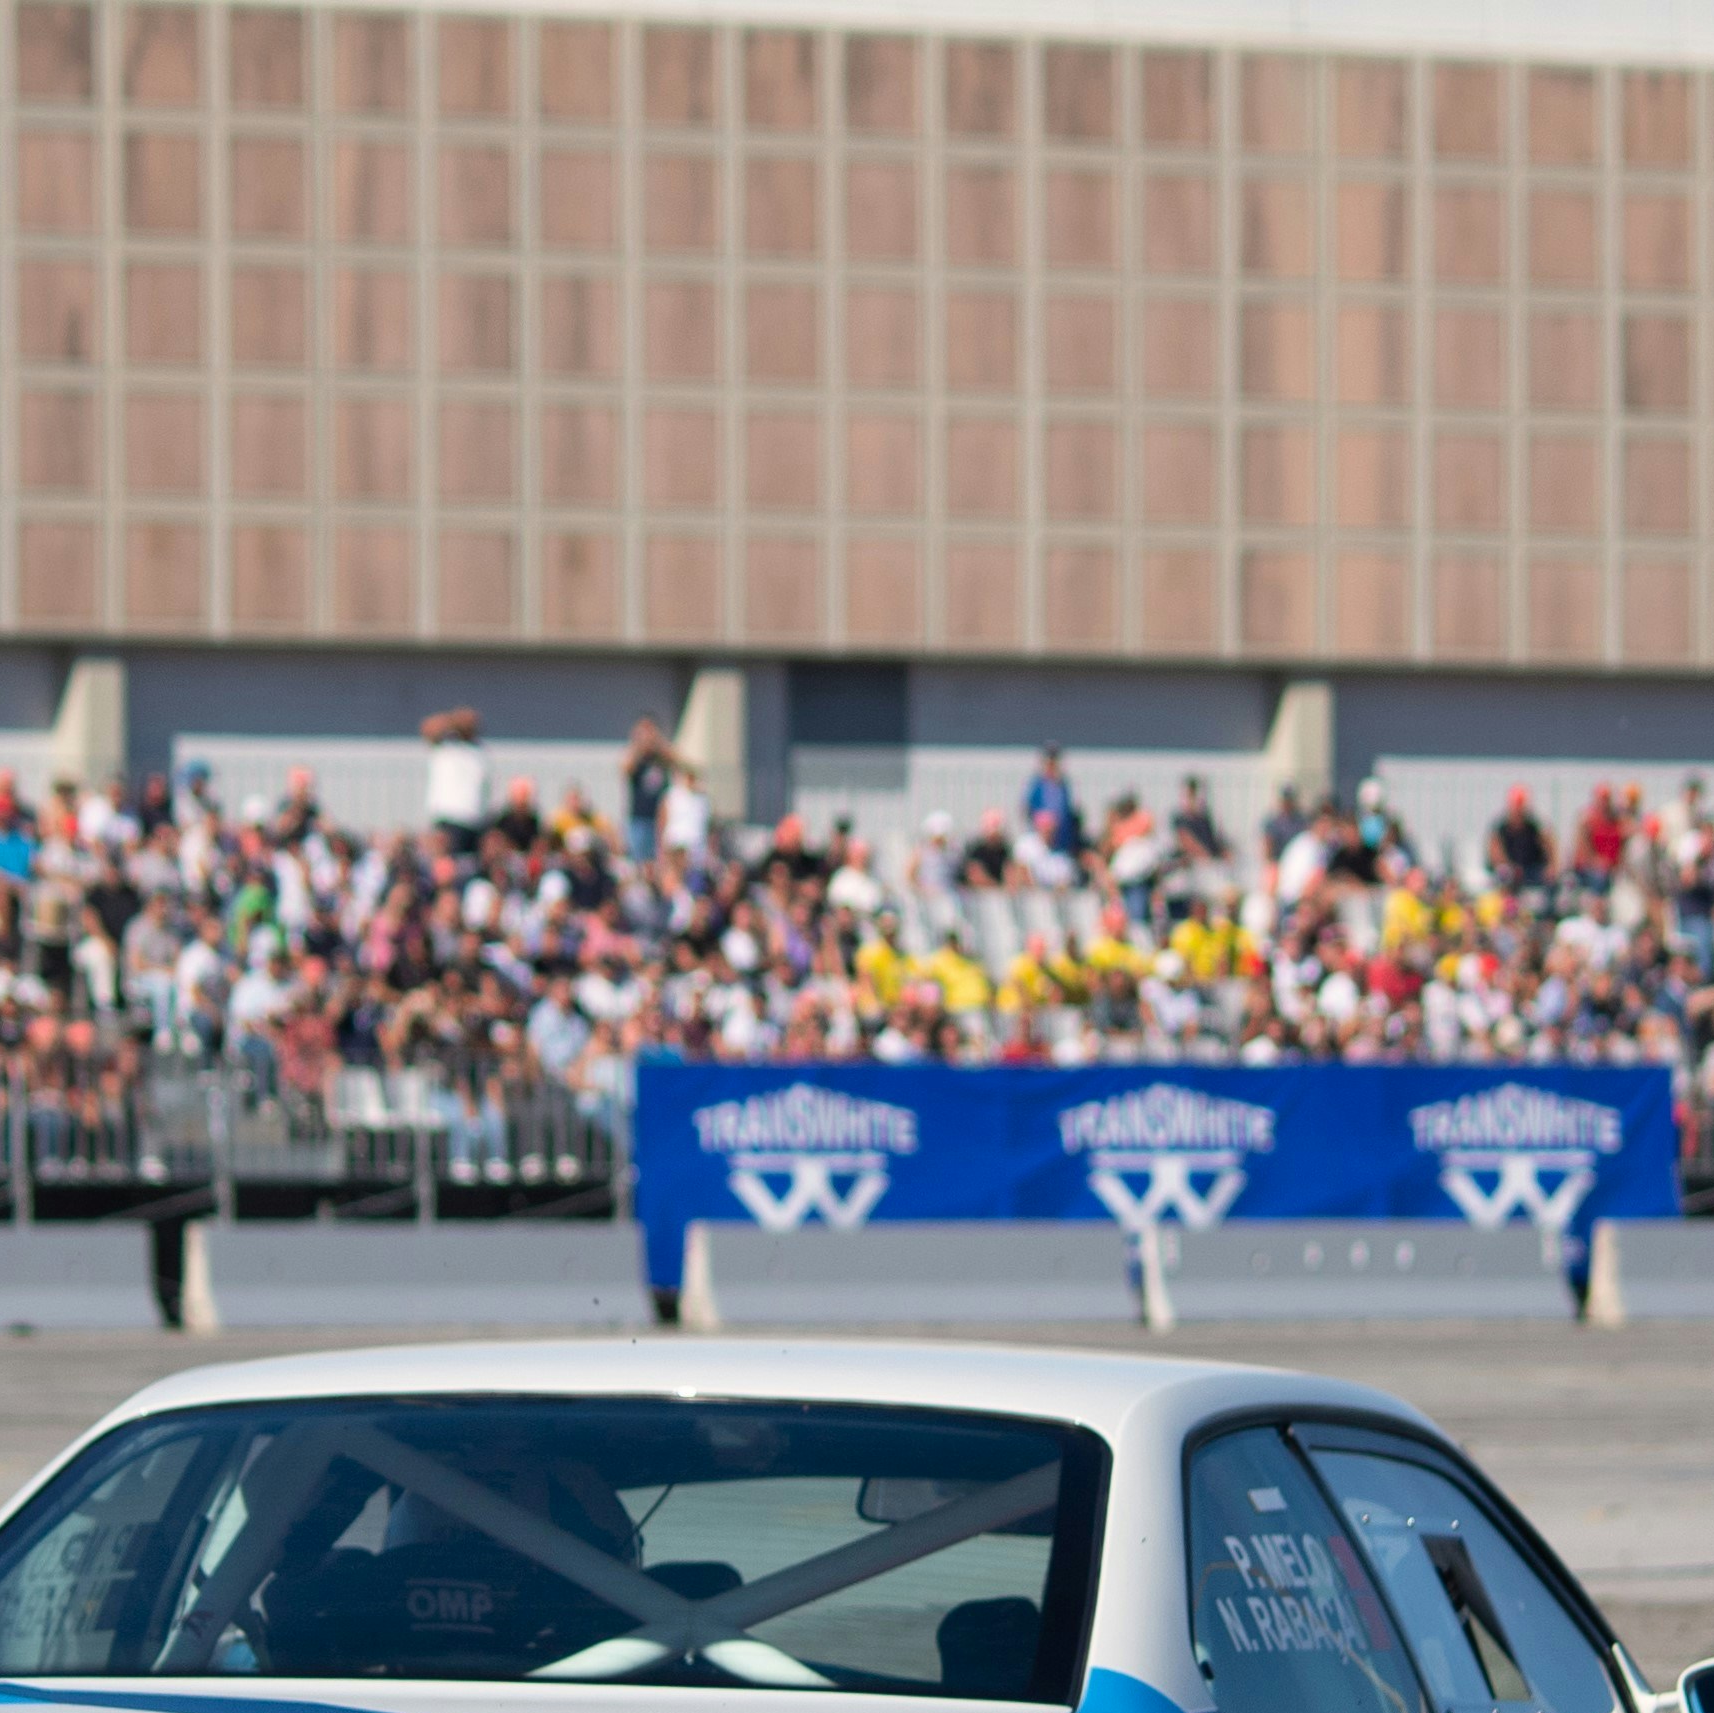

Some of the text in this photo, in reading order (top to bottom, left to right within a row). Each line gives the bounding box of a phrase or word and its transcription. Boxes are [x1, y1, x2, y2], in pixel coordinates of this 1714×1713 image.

[695, 1083, 918, 1154] TRANSWHITE
[1061, 1083, 1274, 1154] TRANSWHITE
[1410, 1083, 1622, 1154] TRANSWHITE
[407, 1588, 493, 1622] OMP
